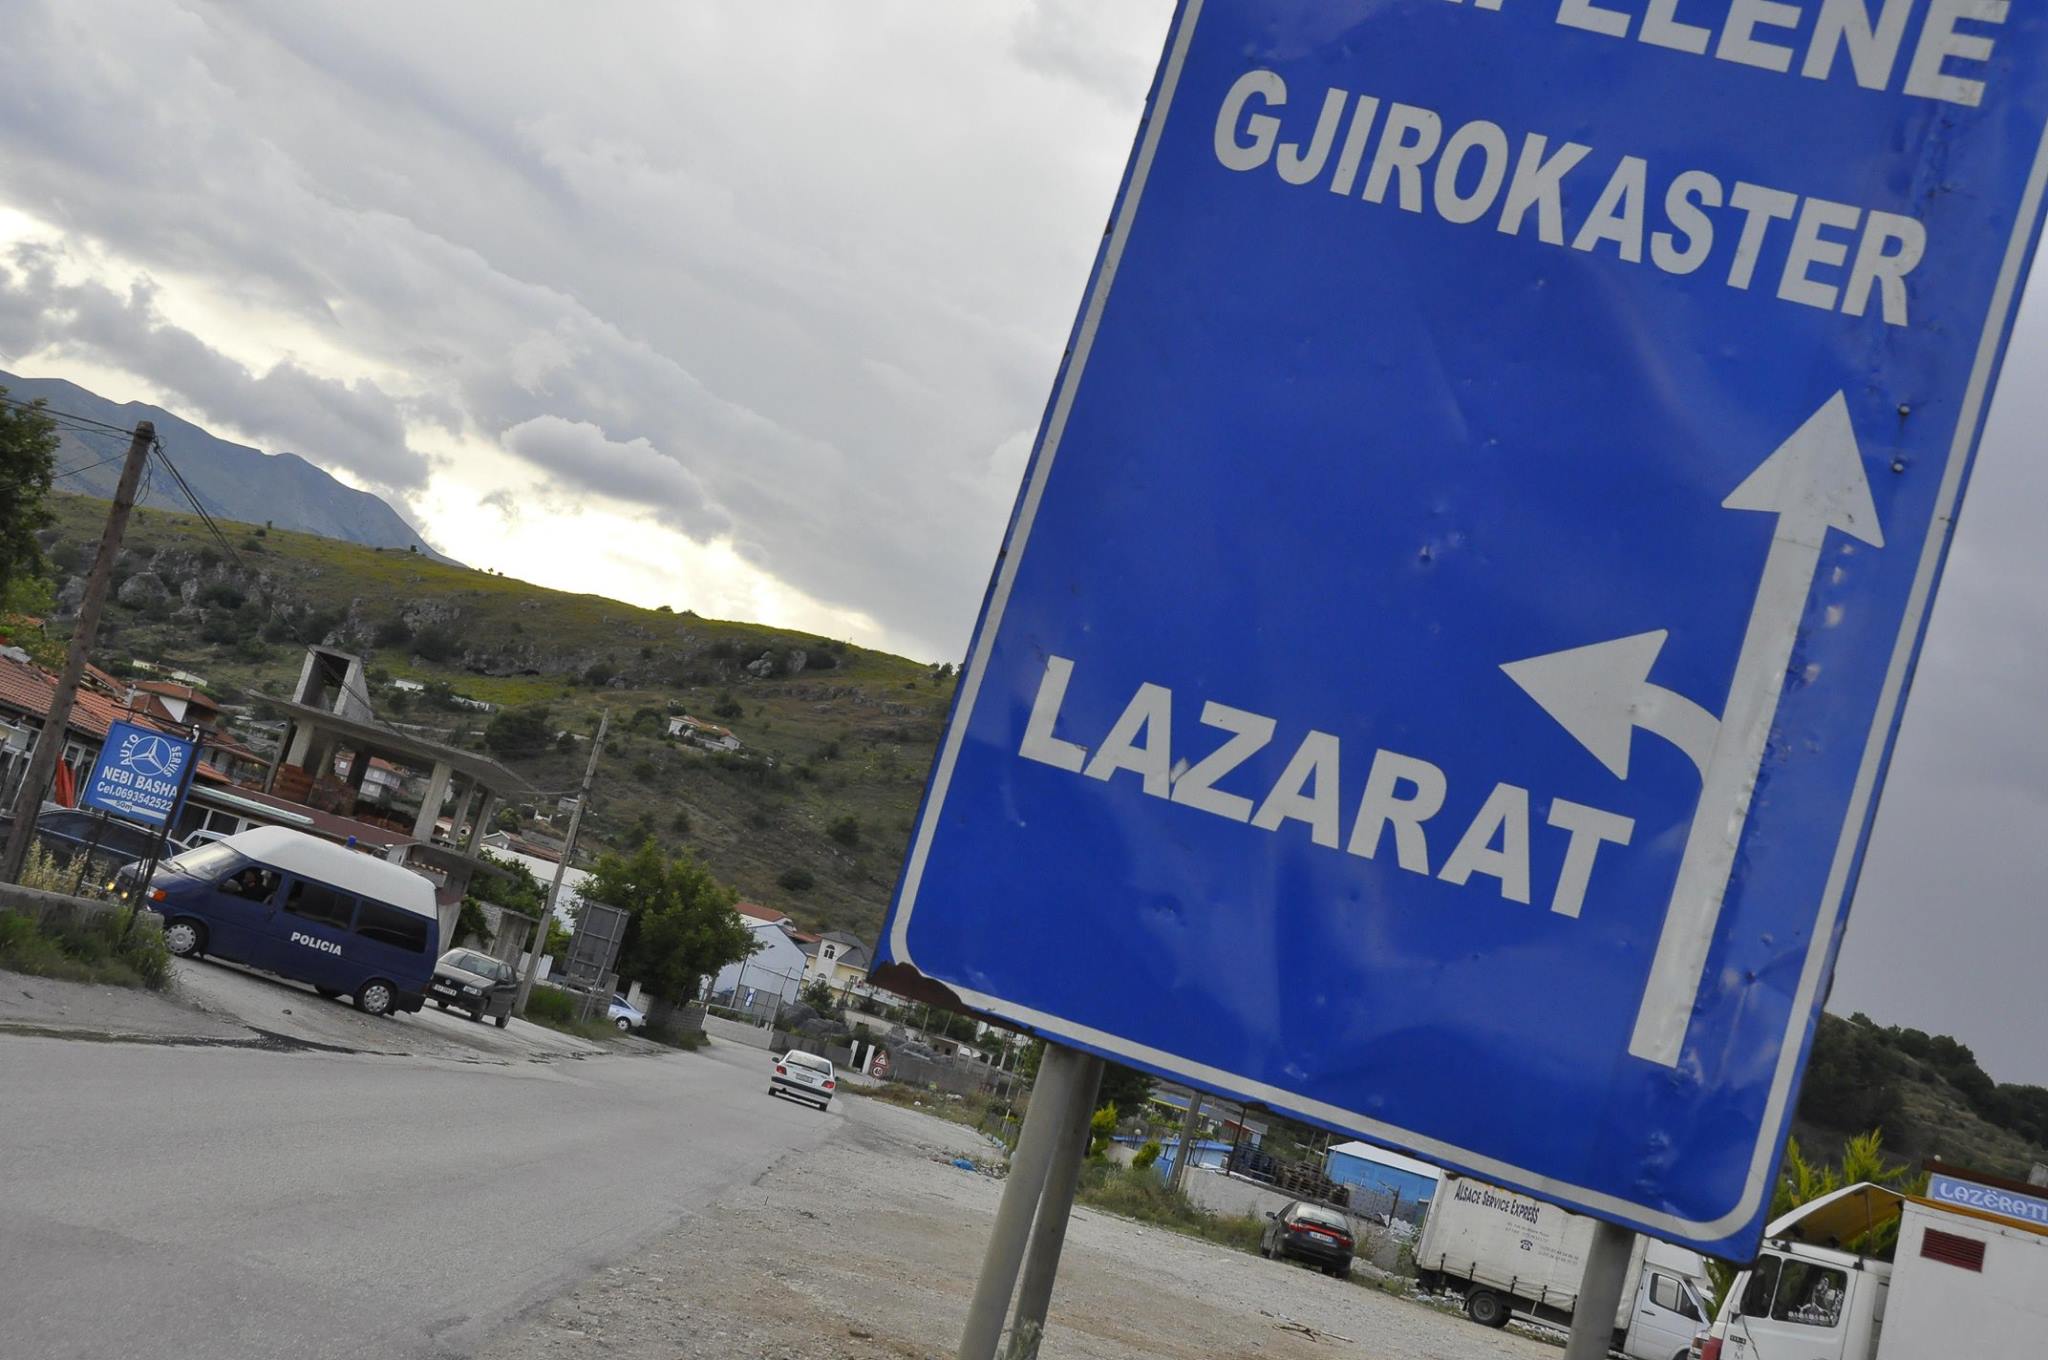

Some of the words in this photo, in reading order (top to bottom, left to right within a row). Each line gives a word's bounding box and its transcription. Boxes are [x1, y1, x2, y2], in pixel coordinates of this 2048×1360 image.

[1214, 69, 1927, 326] GJIROKASTER
[120, 734, 139, 766] AUTO
[163, 745, 182, 778] SERVIS
[102, 765, 134, 786] NEBI
[135, 775, 178, 798] BASHA
[1018, 655, 1636, 919] LAZARAT
[290, 931, 342, 956] POLICIA
[1454, 1180, 1481, 1205] ALSACE
[1482, 1190, 1510, 1213] SERVICE
[1510, 1199, 1540, 1224] EXPRESS
